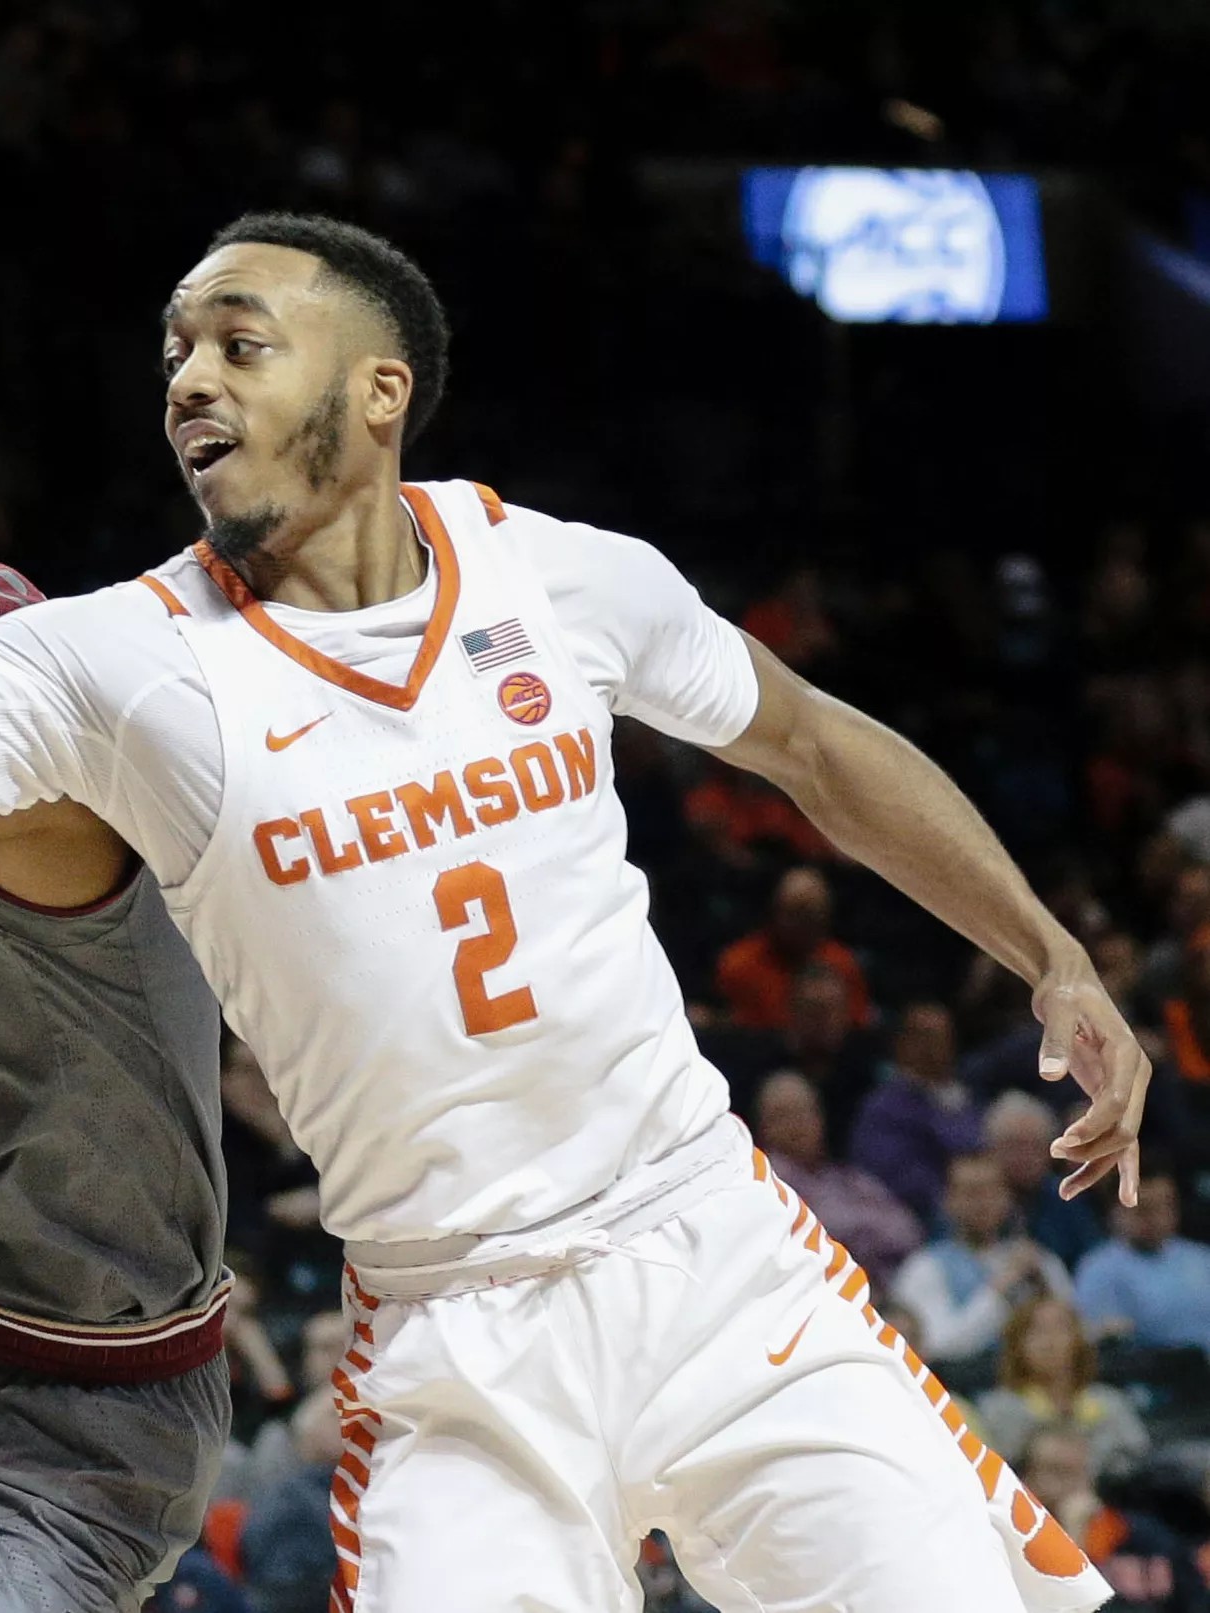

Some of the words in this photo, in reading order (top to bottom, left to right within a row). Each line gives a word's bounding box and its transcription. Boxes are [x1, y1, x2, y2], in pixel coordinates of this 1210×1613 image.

[510, 684, 545, 706] ACC
[252, 728, 597, 887] CLEMSON
[432, 860, 539, 1037] 2
